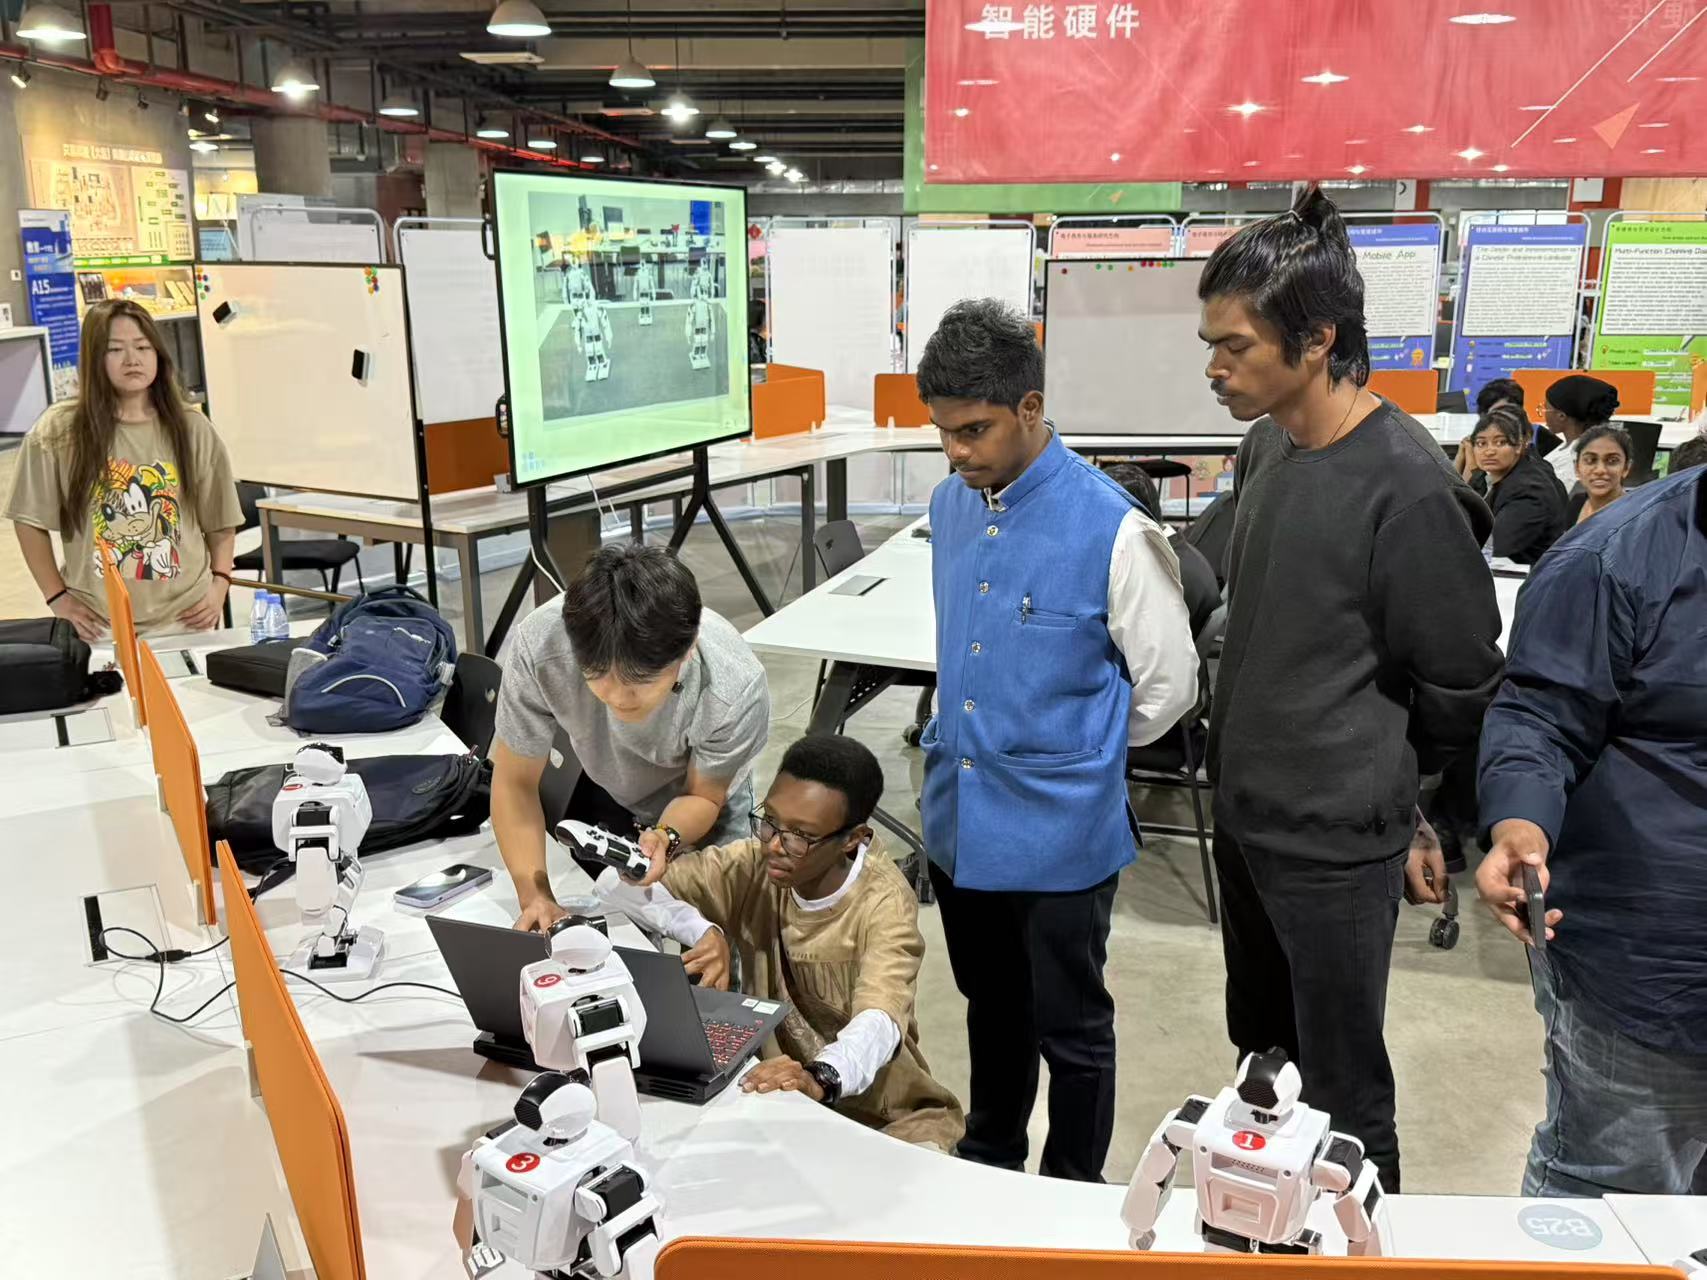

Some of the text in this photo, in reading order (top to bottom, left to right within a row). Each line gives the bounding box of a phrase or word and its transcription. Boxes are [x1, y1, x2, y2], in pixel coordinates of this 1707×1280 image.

[981, 3, 1139, 39] 智能硬件
[1362, 250, 1416, 261] Mobile App
[32, 279, 50, 295] A15
[1239, 1133, 1254, 1149] 1
[511, 1154, 535, 1171] 3
[1526, 1216, 1594, 1238] B25
